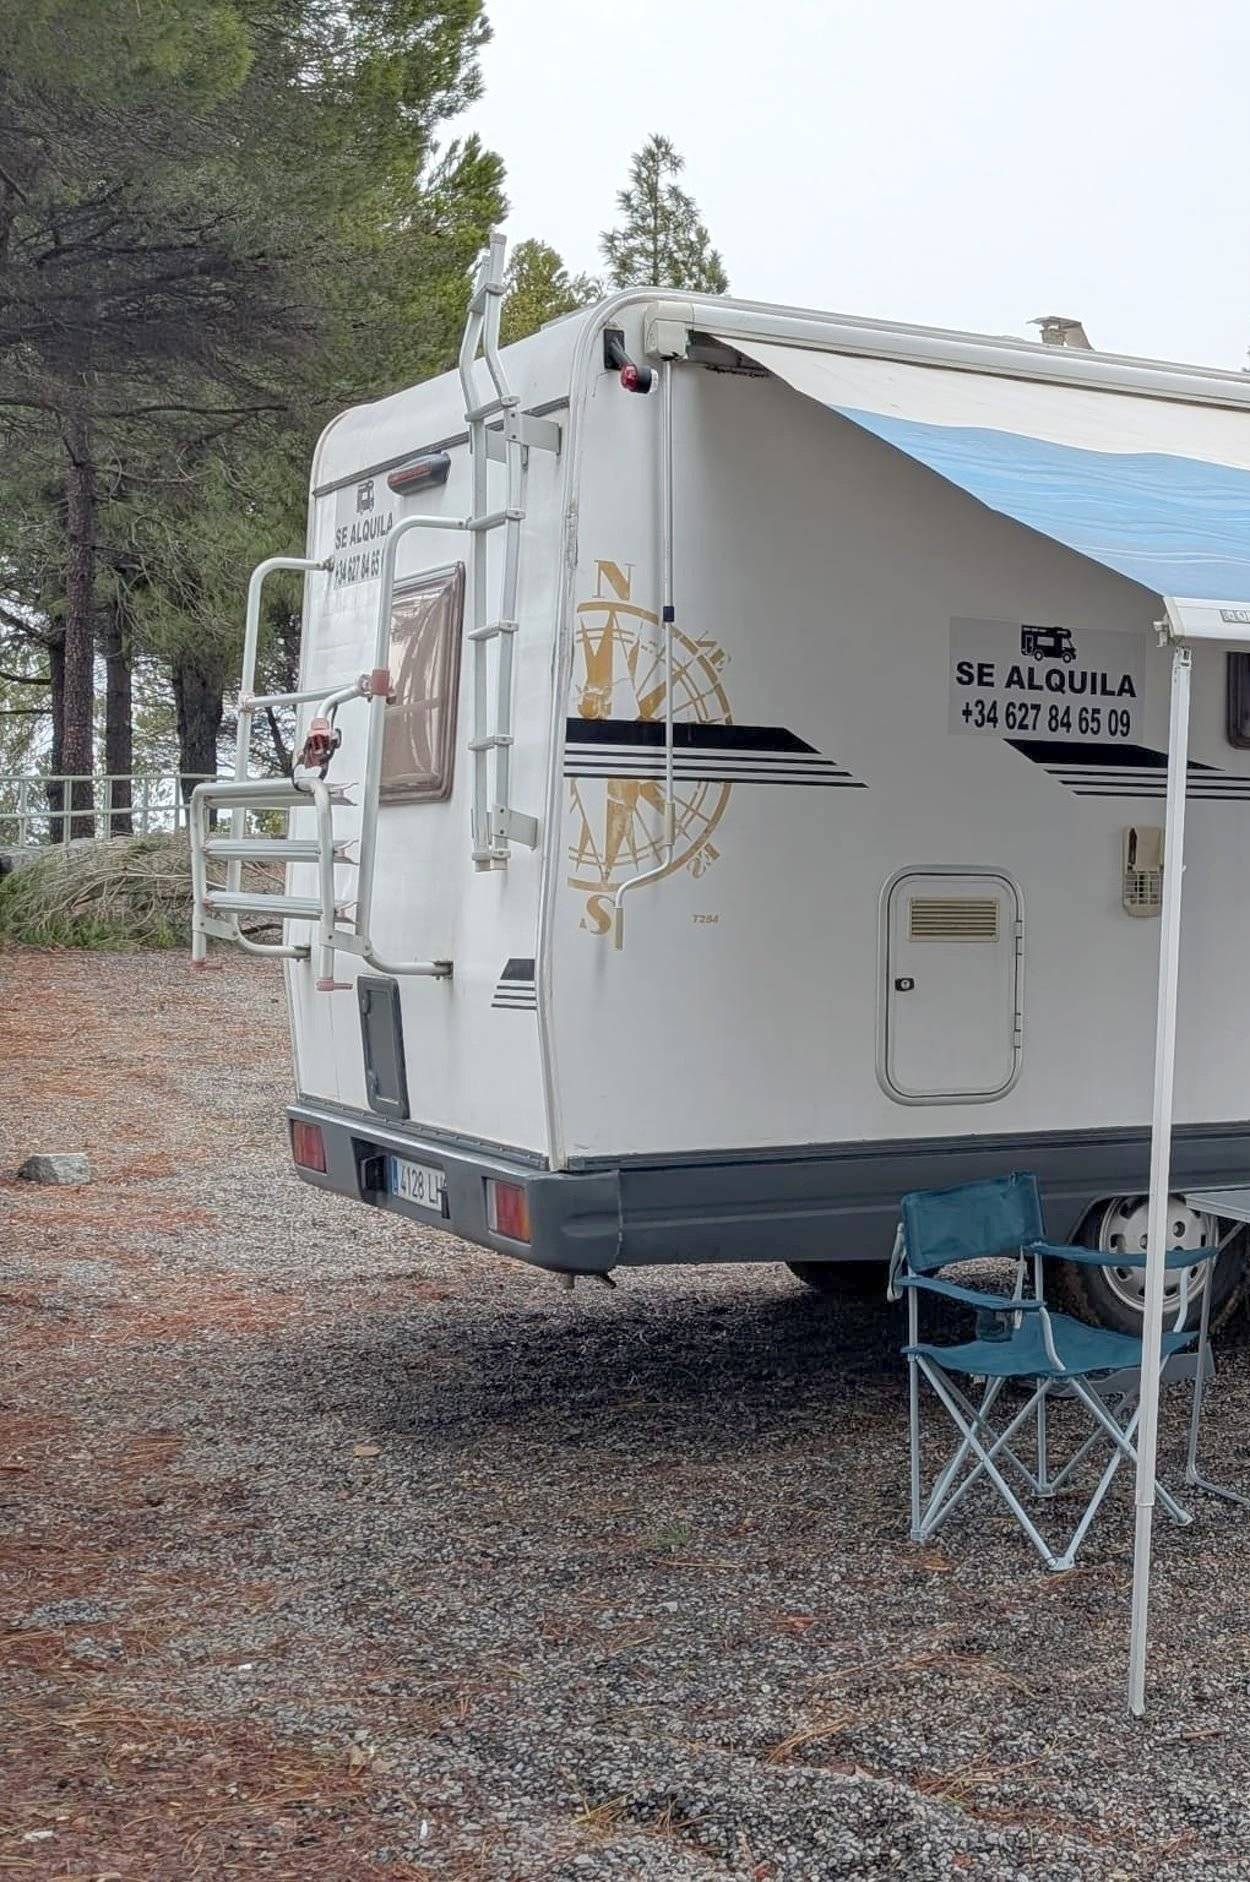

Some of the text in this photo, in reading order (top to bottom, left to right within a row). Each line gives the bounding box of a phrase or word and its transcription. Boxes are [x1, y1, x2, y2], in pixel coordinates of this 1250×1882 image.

[335, 512, 393, 549] SE ALQUILA
[592, 560, 636, 601] N
[955, 661, 1137, 698] SE ALQUILA
[962, 699, 1131, 737] +34 627 84 65 09
[586, 894, 616, 936] S
[400, 1164, 424, 1199] 4128
